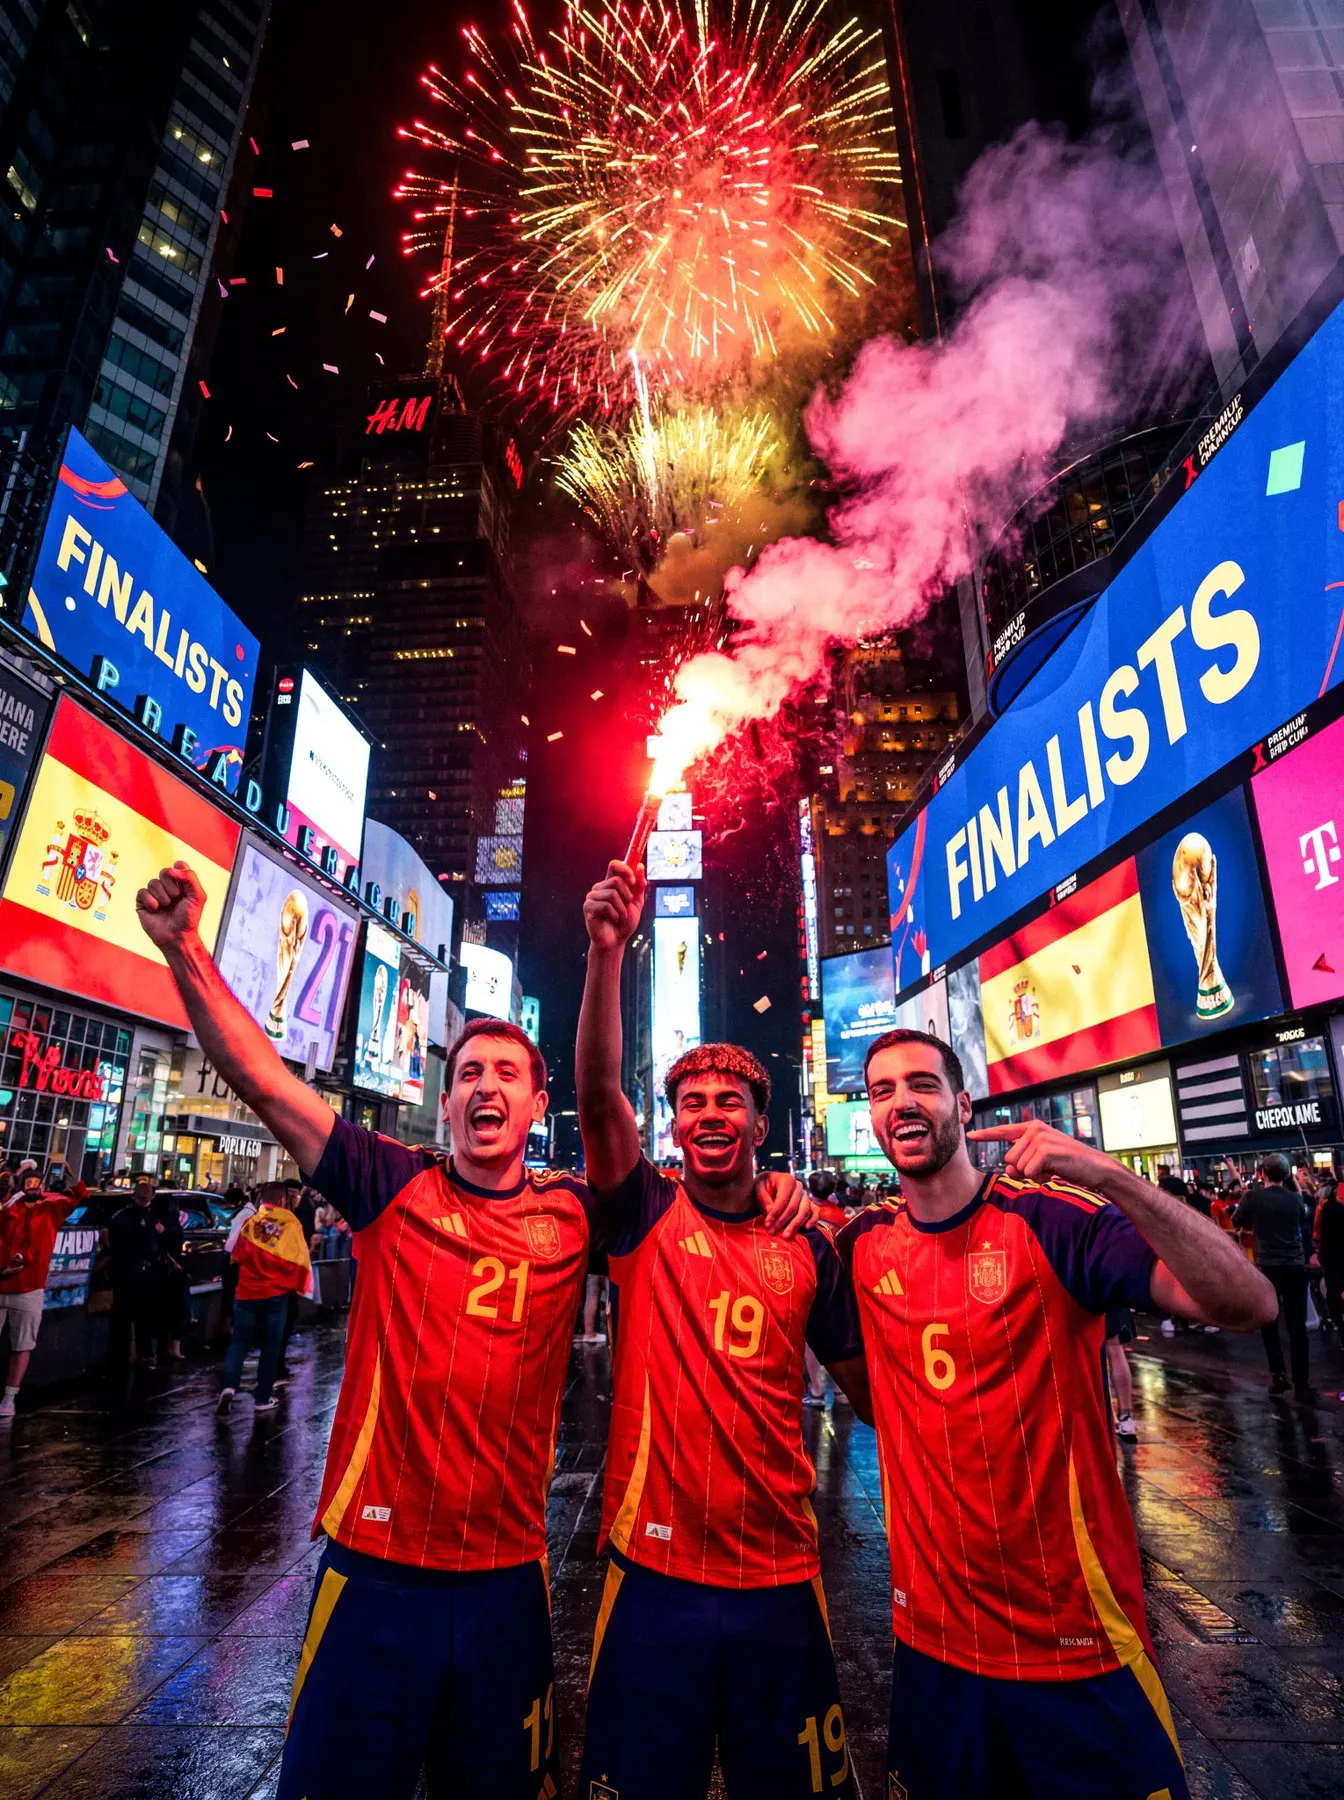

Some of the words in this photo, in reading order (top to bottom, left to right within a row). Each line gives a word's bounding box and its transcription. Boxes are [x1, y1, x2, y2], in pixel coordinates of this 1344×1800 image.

[365, 396, 432, 434] H&M
[57, 514, 244, 727] FINALISTS
[945, 560, 1260, 920] FINALISTS
[466, 1256, 529, 1322] 21
[708, 1290, 764, 1358] 19
[922, 1323, 956, 1390] 6
[798, 1703, 848, 1793] 19
